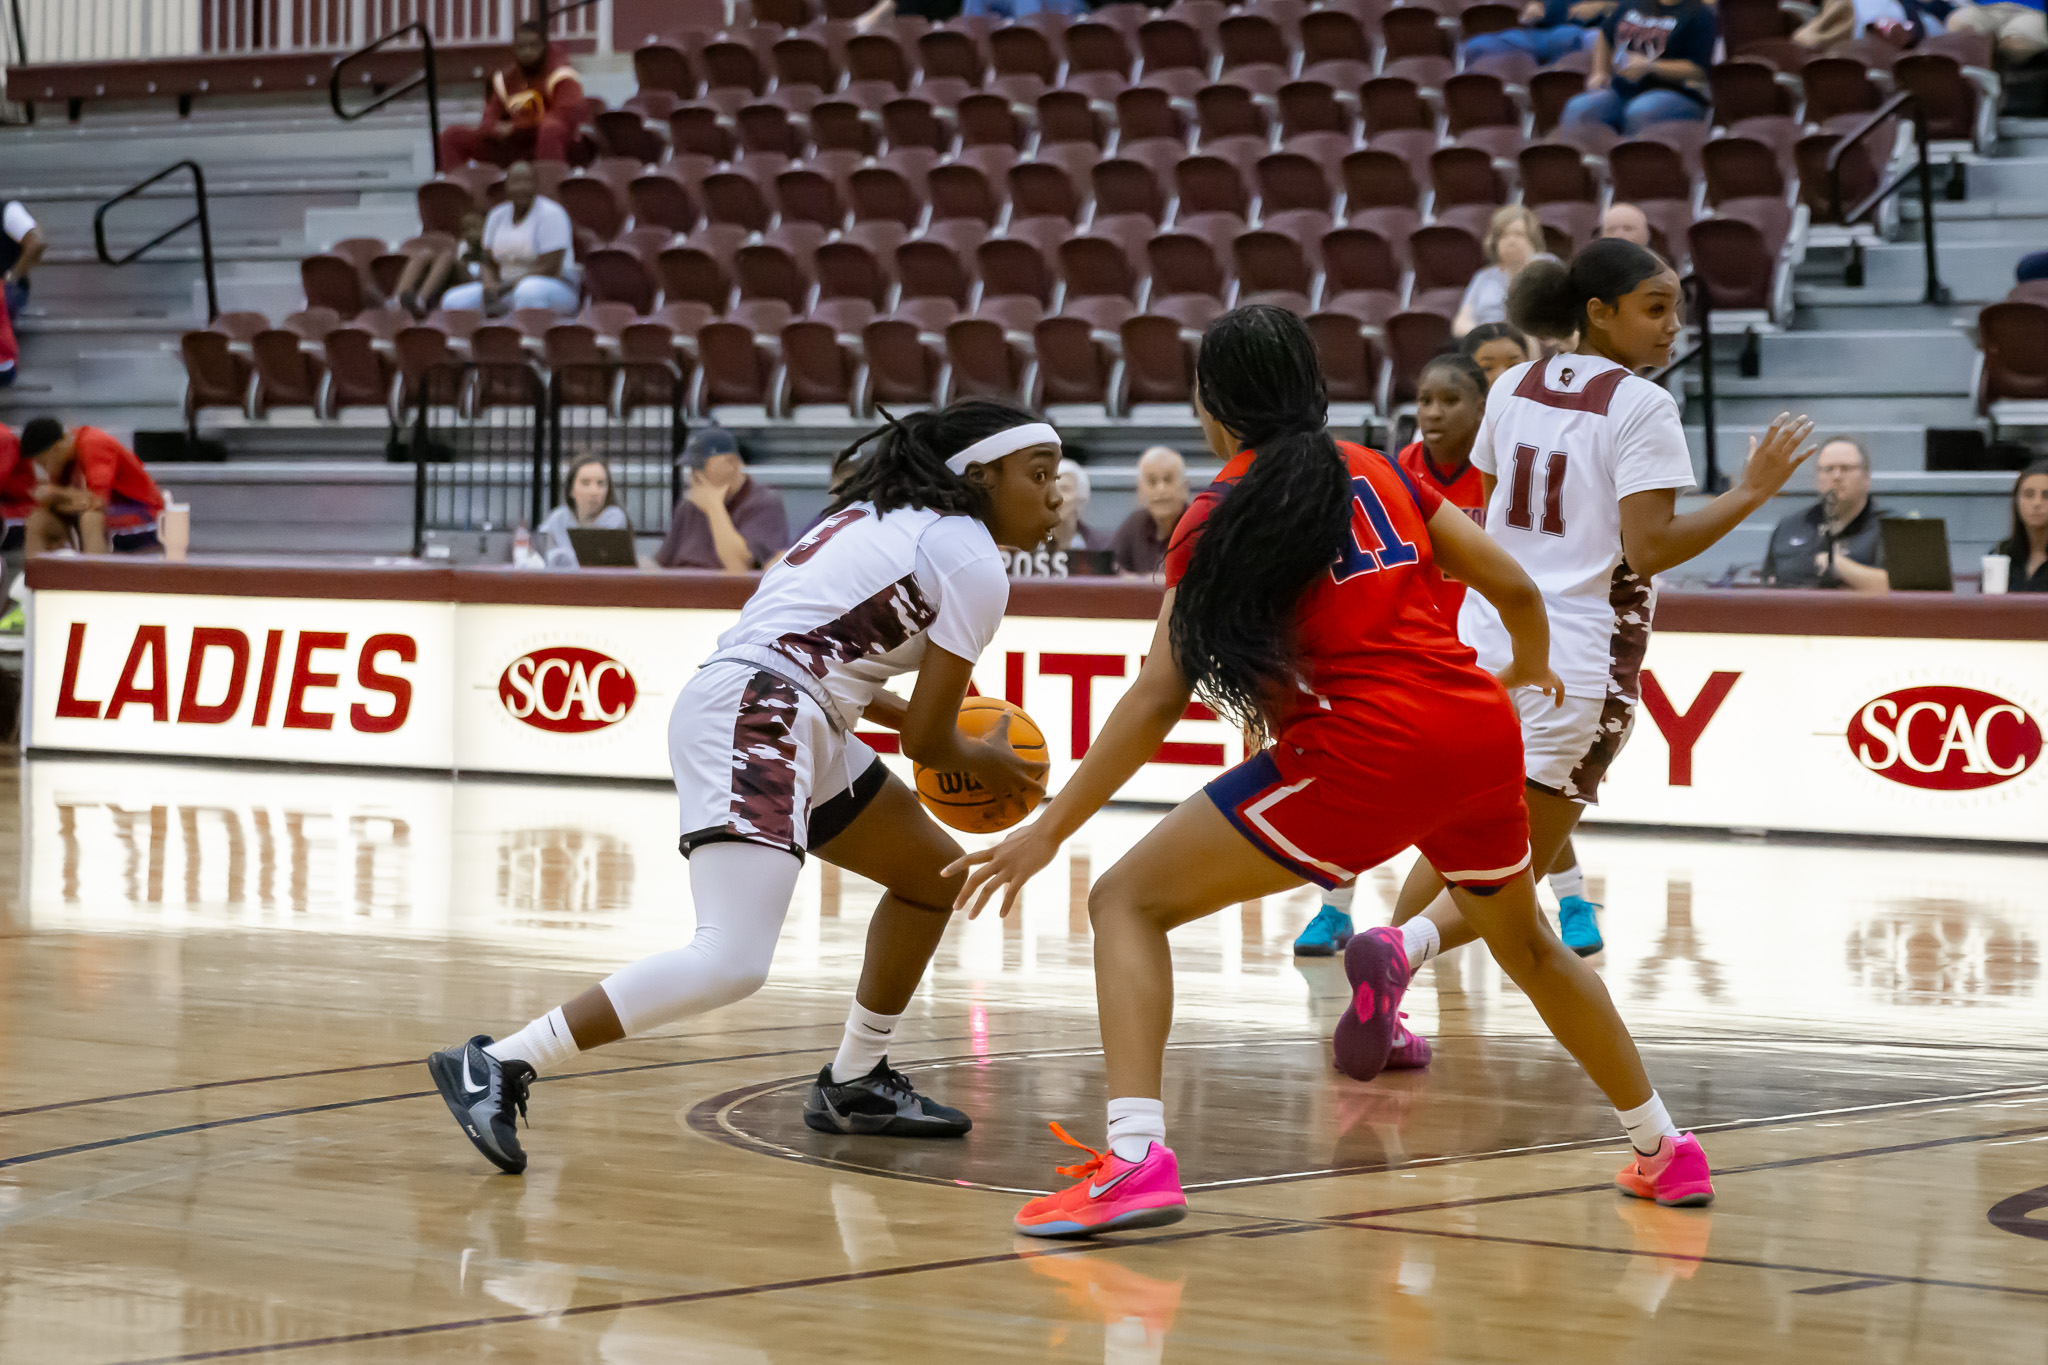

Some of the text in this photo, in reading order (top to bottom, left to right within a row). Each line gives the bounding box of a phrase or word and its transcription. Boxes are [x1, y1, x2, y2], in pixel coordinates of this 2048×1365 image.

[1506, 442, 1568, 538] 11
[55, 622, 418, 734] LADIES
[506, 656, 627, 723] SCAC
[1859, 698, 2026, 777] SCAC
